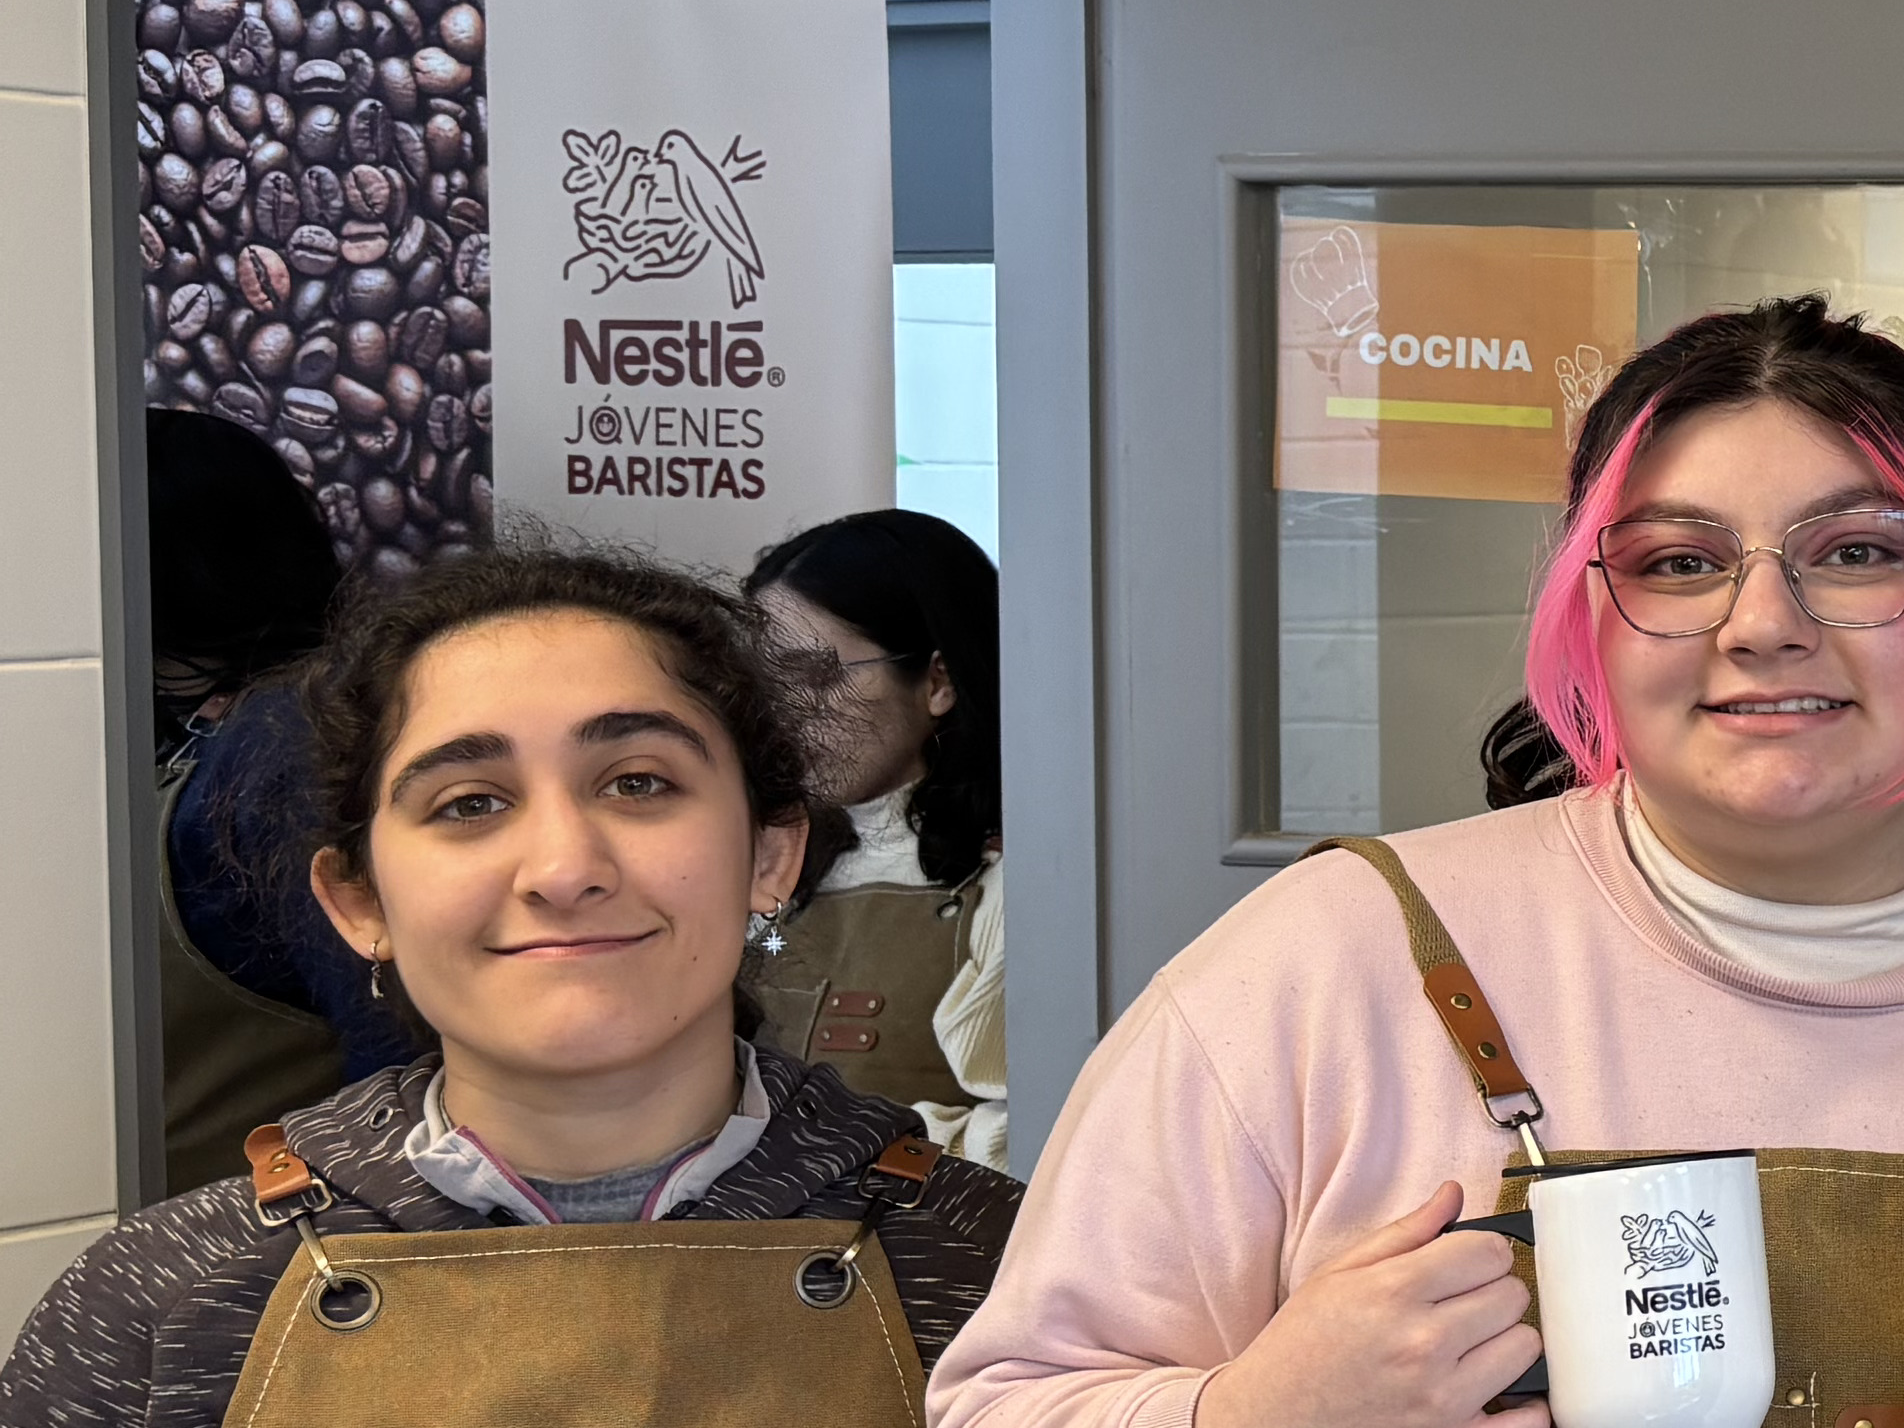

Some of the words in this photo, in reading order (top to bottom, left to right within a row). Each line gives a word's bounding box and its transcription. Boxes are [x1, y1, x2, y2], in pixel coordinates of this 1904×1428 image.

[1359, 332, 1533, 372] COCINA
[563, 393, 765, 449] JÓVENES
[566, 454, 766, 500] BARISTAS
[1625, 1279, 1722, 1316] Nestlé
[1628, 1314, 1724, 1340] JÓVENES
[1629, 1333, 1726, 1359] BARISTAS
